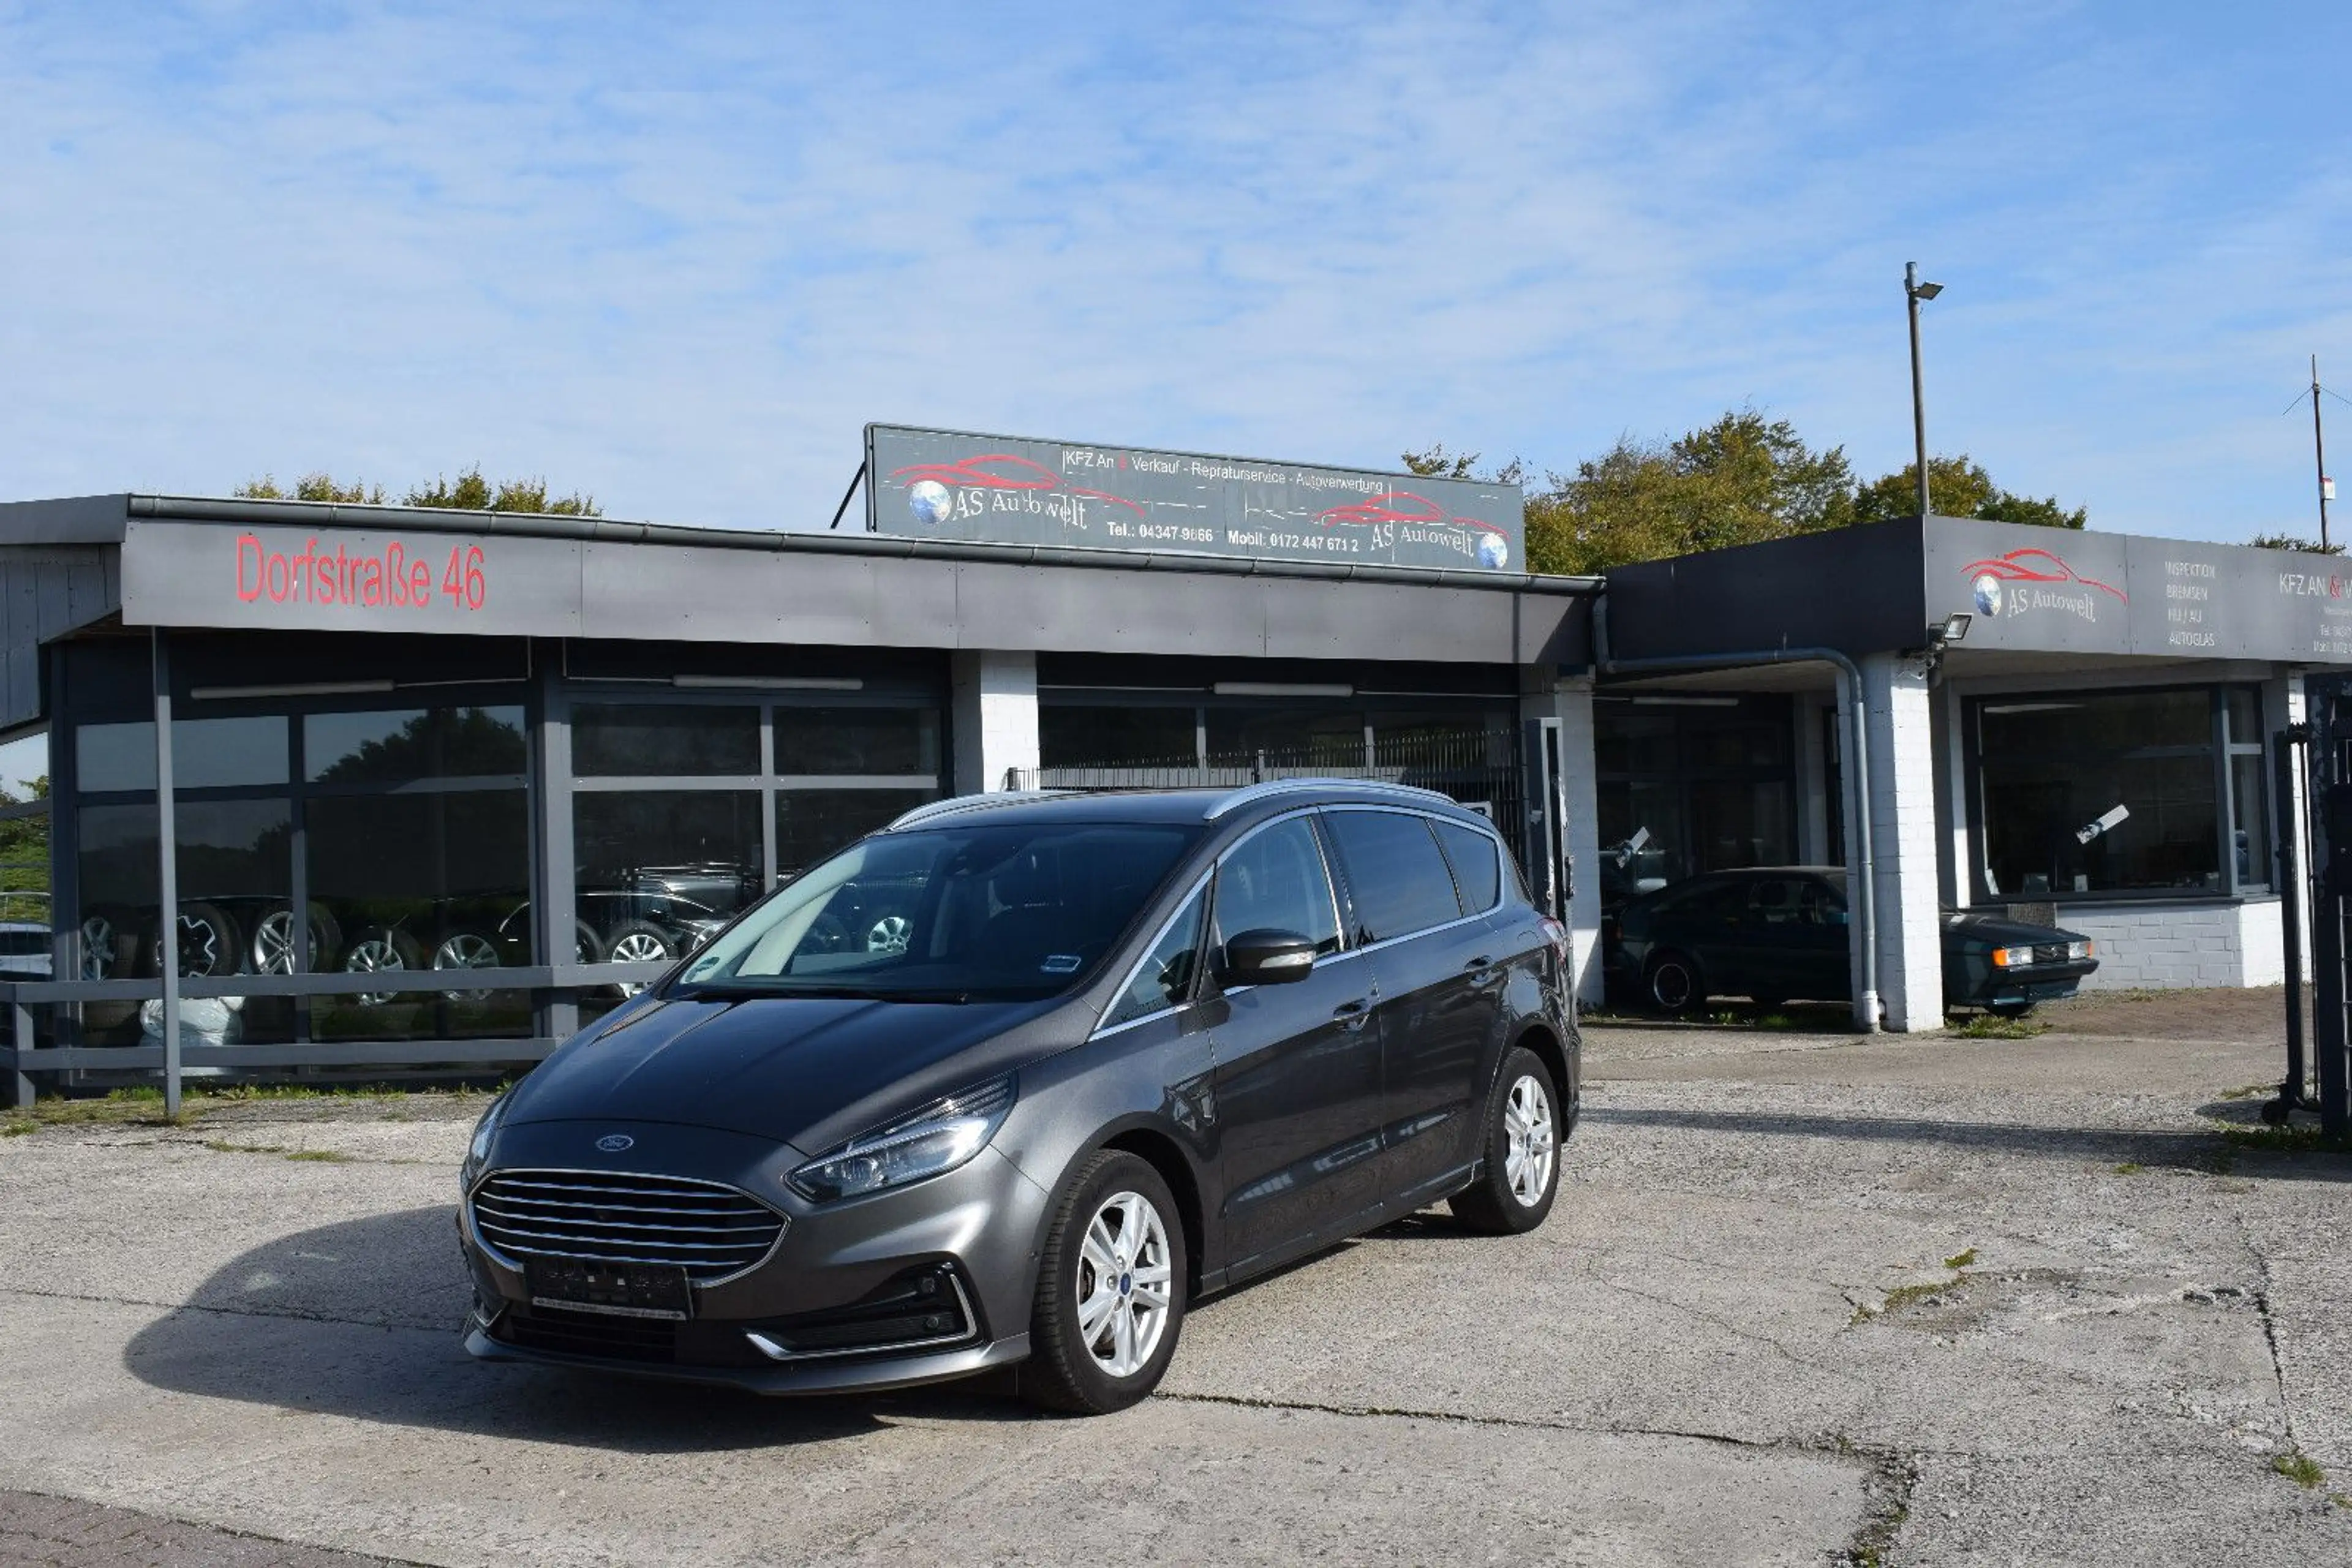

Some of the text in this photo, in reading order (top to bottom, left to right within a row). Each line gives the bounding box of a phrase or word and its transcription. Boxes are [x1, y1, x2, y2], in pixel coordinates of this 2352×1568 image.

[1066, 450, 1093, 467] KFZ
[1096, 454, 1114, 468] An
[1133, 457, 1180, 473] Verkauf
[1296, 473, 1384, 494] Autoverwertung
[952, 489, 1088, 530] AS Autowelt
[1270, 533, 1299, 548] 0172
[1302, 536, 1324, 549] 447
[1327, 538, 1348, 551] 671
[1351, 538, 1359, 552] 2
[1371, 524, 1474, 557] AS Autowelt
[236, 535, 485, 609] Dorfstraße 46
[2279, 573, 2305, 595] KFZ
[2308, 576, 2328, 597] AN
[2008, 589, 2096, 623] AS Autowelt
[2166, 584, 2208, 601] BREMSEN
[2169, 631, 2215, 647] AUTOGLAS
